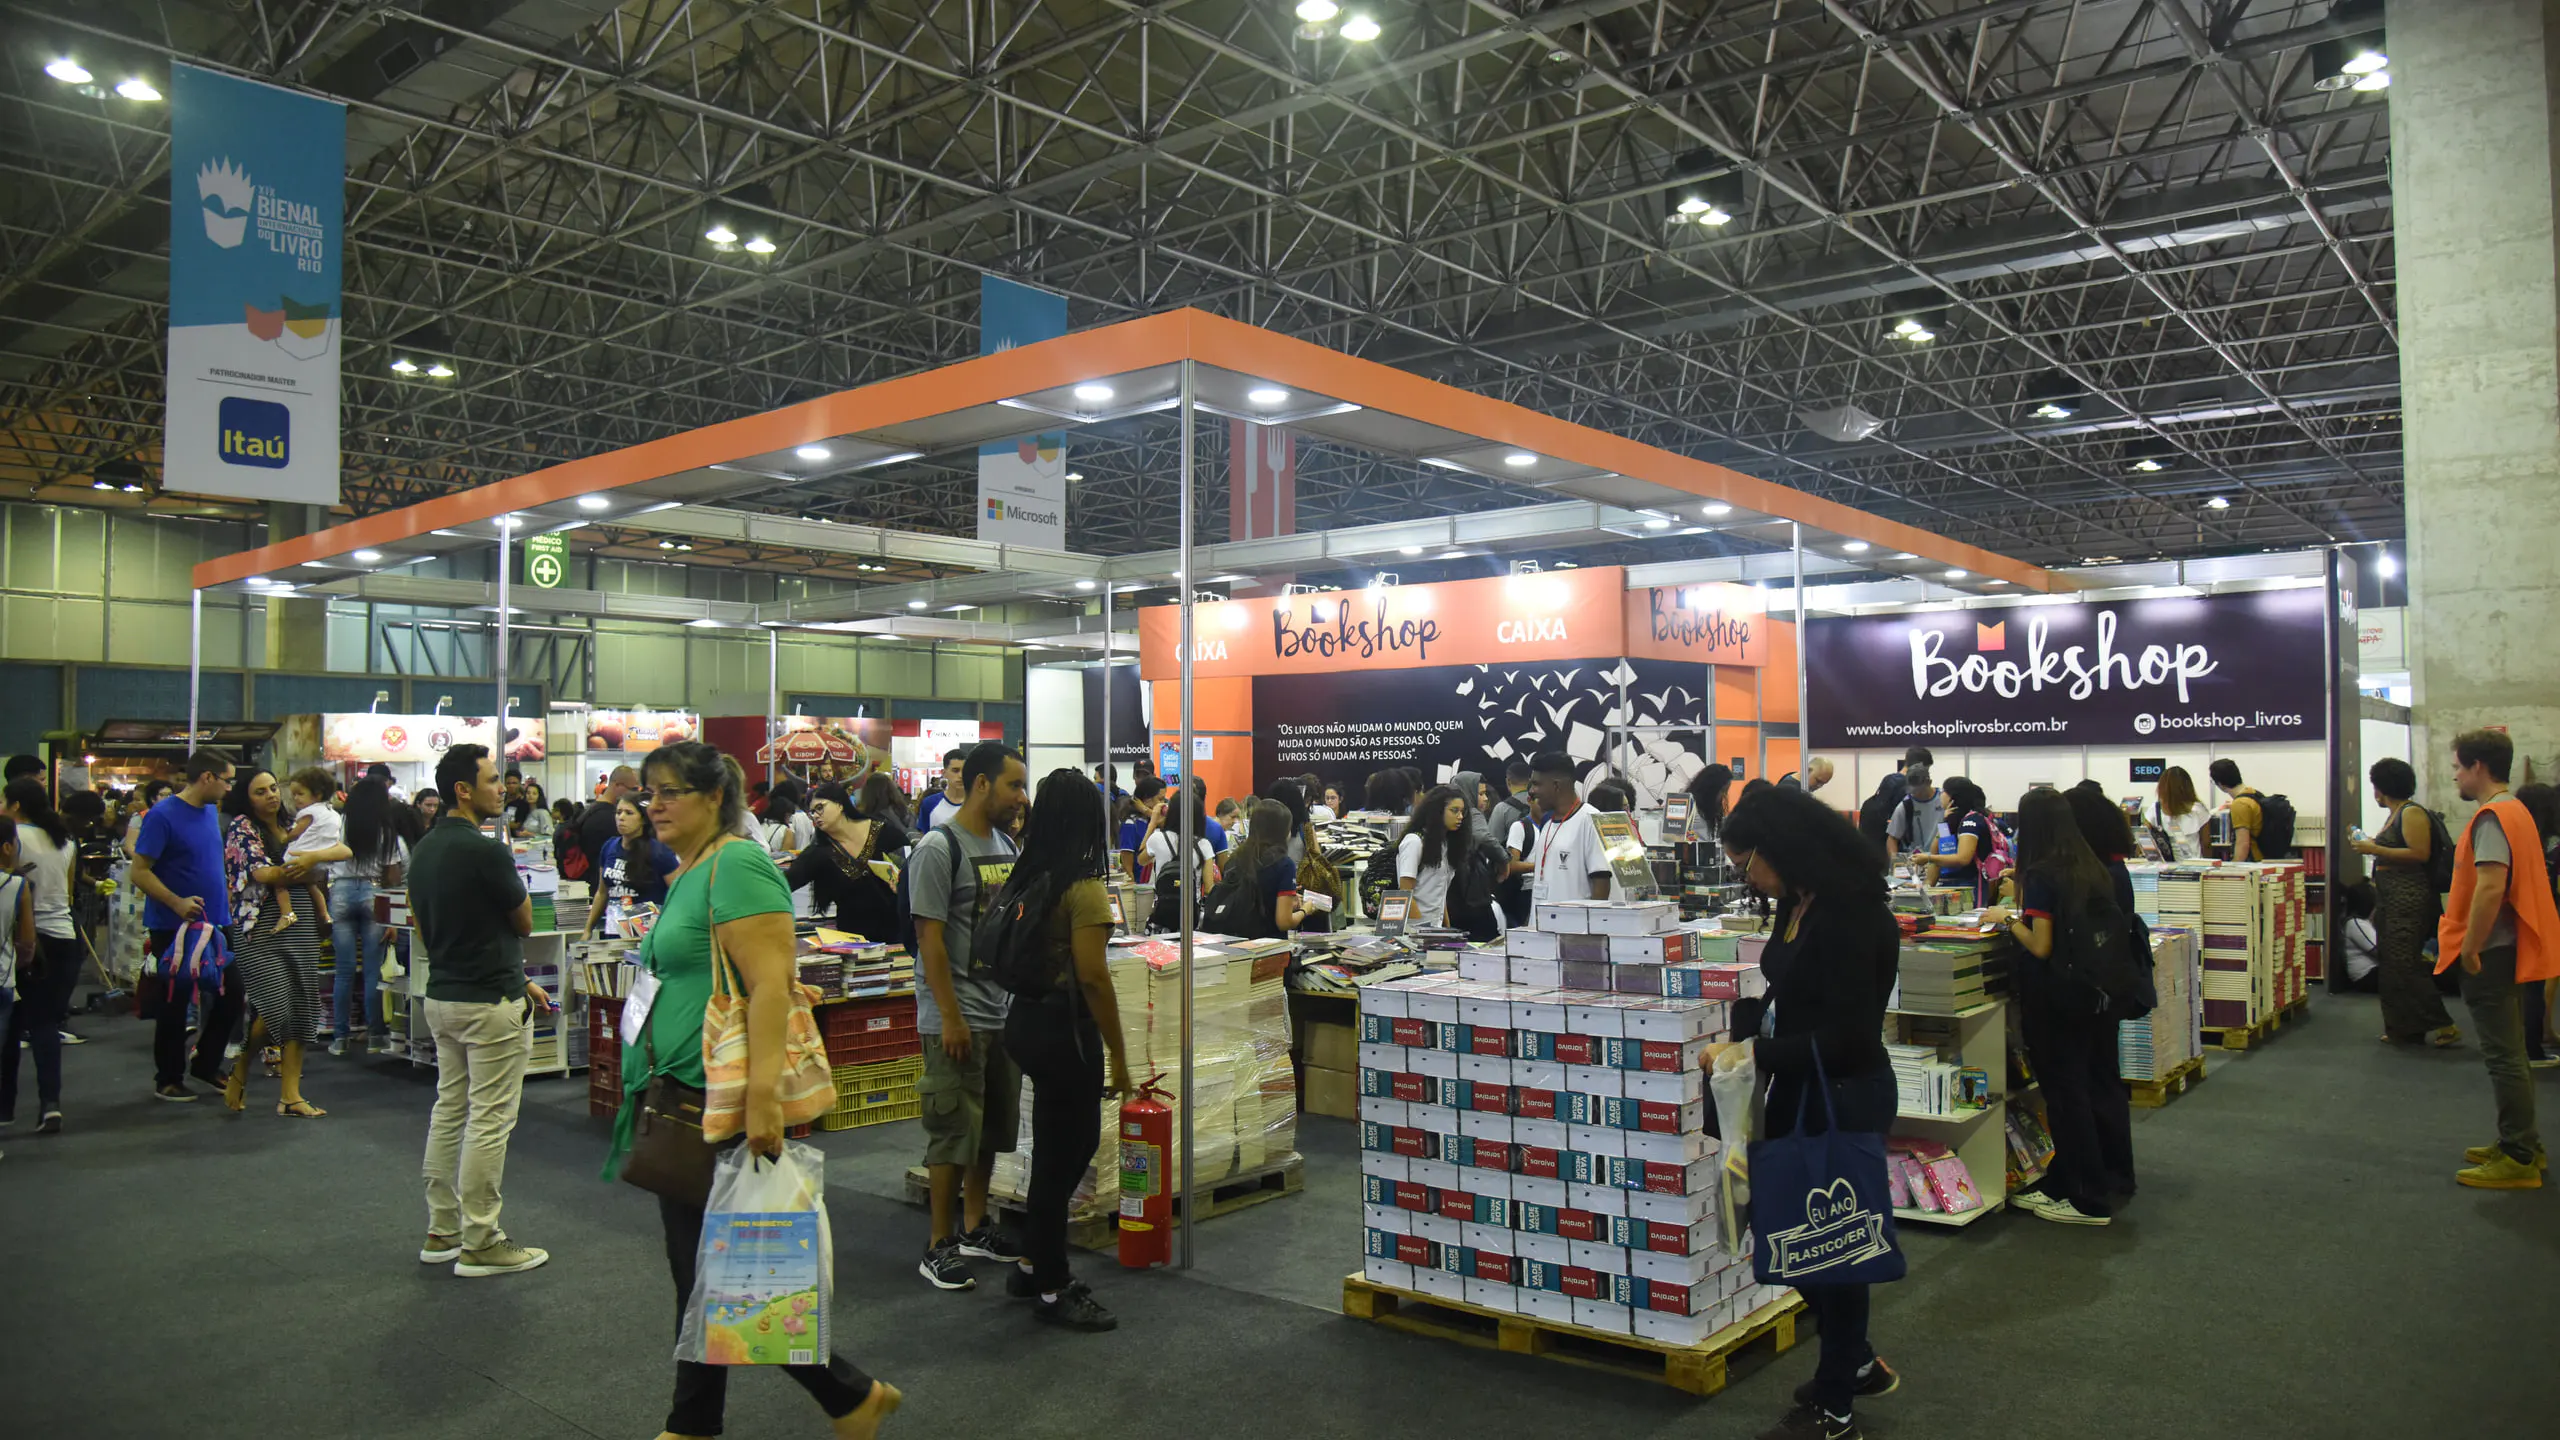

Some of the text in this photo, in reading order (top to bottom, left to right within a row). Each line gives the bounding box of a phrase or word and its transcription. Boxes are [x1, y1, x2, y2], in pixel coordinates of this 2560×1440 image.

[258, 185, 275, 196] XIX
[257, 195, 323, 227] BIENAL
[258, 229, 323, 260] DO LIVRO
[297, 257, 322, 273] RIO
[209, 367, 296, 386] PATROCINADOR MASTER
[224, 429, 285, 459] Itaú
[1007, 505, 1058, 526] Microsoft
[1273, 597, 1442, 660] Bookshop
[1909, 610, 2218, 703] Bookshop
[2160, 710, 2302, 731] bookshop_livros
[1295, 723, 1324, 735] LIVROS
[1326, 721, 1346, 734] NÃO
[1347, 722, 1383, 733] MUDAM
[1385, 722, 1392, 732] O
[1393, 722, 1433, 733] MUNDO,
[1434, 720, 1464, 733] QUEM
[1846, 717, 2068, 738] www.bookshoplivrosbr.com.br
[1278, 739, 1304, 748] MUDA
[1305, 738, 1312, 748] O
[1313, 737, 1348, 748] MUNDO
[1349, 734, 1368, 747] SÃO
[1369, 737, 1381, 746] AS
[1383, 736, 1425, 746] PESSOAS.
[1278, 752, 1308, 762] LIVROS
[1309, 749, 1320, 761] SÓ
[1322, 751, 1357, 761] MUDAM
[1358, 751, 1370, 760] AS
[2135, 766, 2161, 775] SEBO
[1670, 971, 1678, 994] VADE
[1703, 980, 1730, 988] saraiva
[1395, 1027, 1417, 1036] saraiva
[1475, 1036, 1499, 1045] saraiva
[1557, 1043, 1583, 1051] saraiva
[1644, 1051, 1671, 1059] saraiva
[1394, 1082, 1417, 1090] saraiva
[1475, 1092, 1499, 1101] saraiva
[1527, 1099, 1552, 1108] saraiva
[1642, 1112, 1669, 1121] saraiva
[1395, 1136, 1417, 1145] saraiva
[1476, 1149, 1501, 1158] saraiva
[1530, 1158, 1555, 1168] saraiva
[1648, 1173, 1674, 1182] saraiva
[1397, 1191, 1420, 1200] saraiva
[1447, 1201, 1471, 1210] saraiva
[1812, 1206, 1826, 1222] EU
[1560, 1219, 1586, 1228] saraiva
[1651, 1232, 1678, 1242] saraiva
[1399, 1244, 1421, 1254] saraiva
[1788, 1227, 1867, 1264] PLASTCOVER
[1478, 1261, 1502, 1270] saraiva
[1563, 1276, 1588, 1286] saraiva
[1652, 1292, 1679, 1302] saraiva
